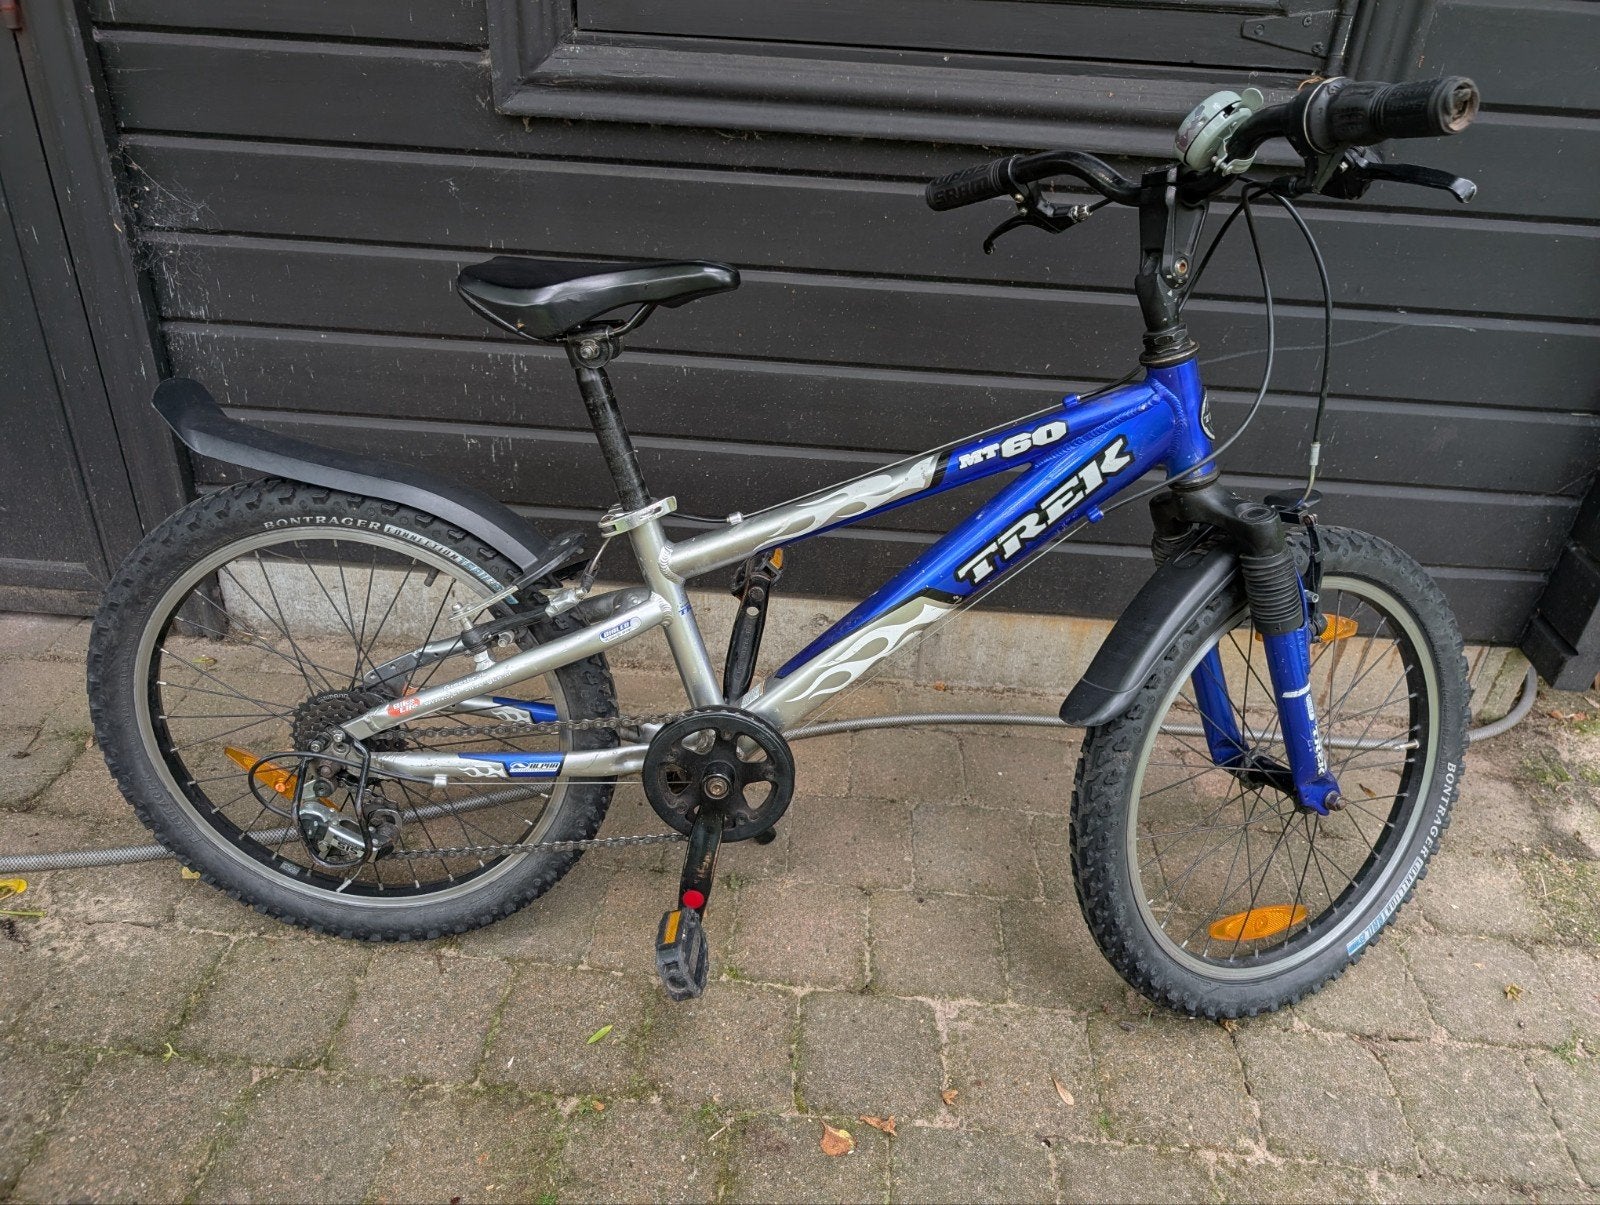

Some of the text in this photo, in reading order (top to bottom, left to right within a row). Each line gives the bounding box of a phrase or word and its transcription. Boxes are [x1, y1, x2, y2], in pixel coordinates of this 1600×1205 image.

[263, 516, 381, 530] BONTRAGER
[957, 438, 1131, 583] TREK
[1421, 762, 1456, 859] BONTRAGER
